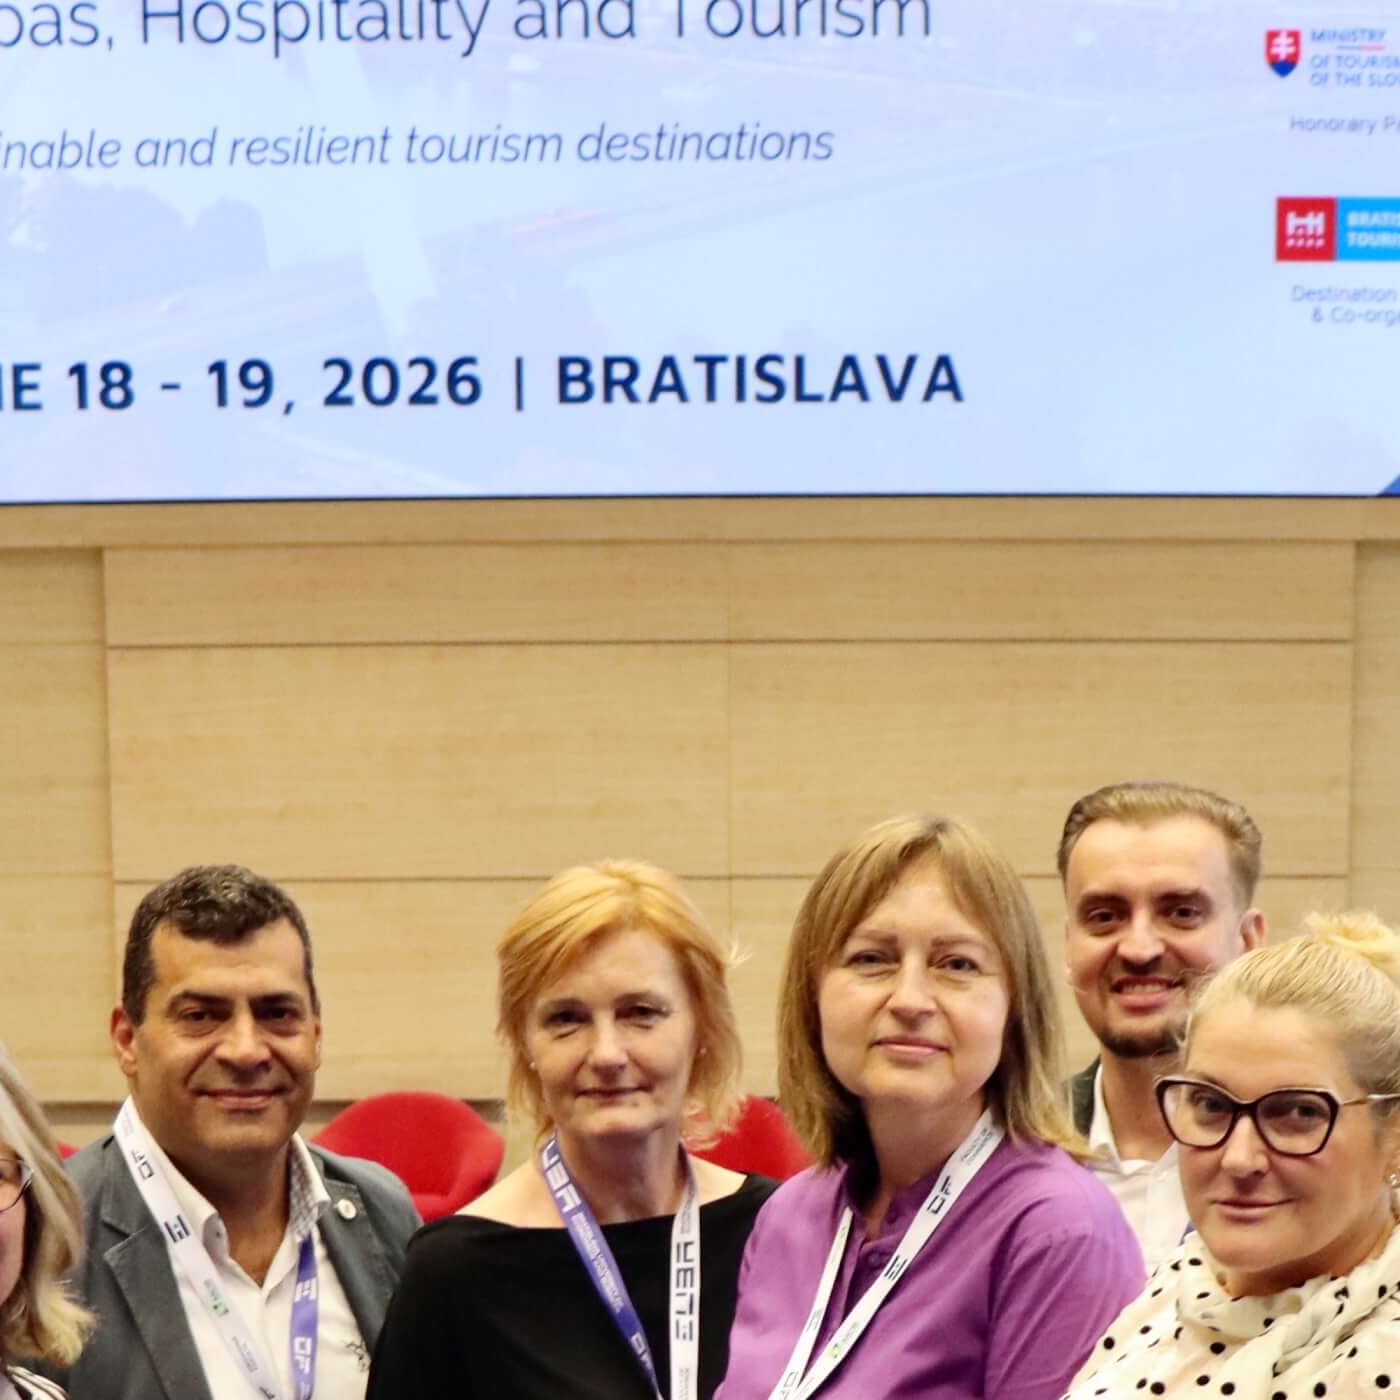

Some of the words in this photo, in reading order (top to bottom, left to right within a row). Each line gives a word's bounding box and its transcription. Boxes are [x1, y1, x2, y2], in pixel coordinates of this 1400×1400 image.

[142, 0, 491, 58] Hospitality
[513, 0, 636, 40] and
[1310, 28, 1386, 43] MINISTRY
[1310, 56, 1331, 70] OF
[1310, 73, 1329, 87] OF
[1335, 73, 1363, 87] THE
[1289, 115, 1376, 136] Honorary
[134, 127, 218, 168] and
[228, 126, 391, 166] resilient
[405, 124, 563, 164] tourism
[576, 121, 836, 162] destinations
[1291, 285, 1398, 304] Destination
[66, 360, 136, 412] 18
[206, 358, 295, 416] 19,
[322, 356, 482, 407] 2026
[556, 354, 966, 404] BRATISLAVA
